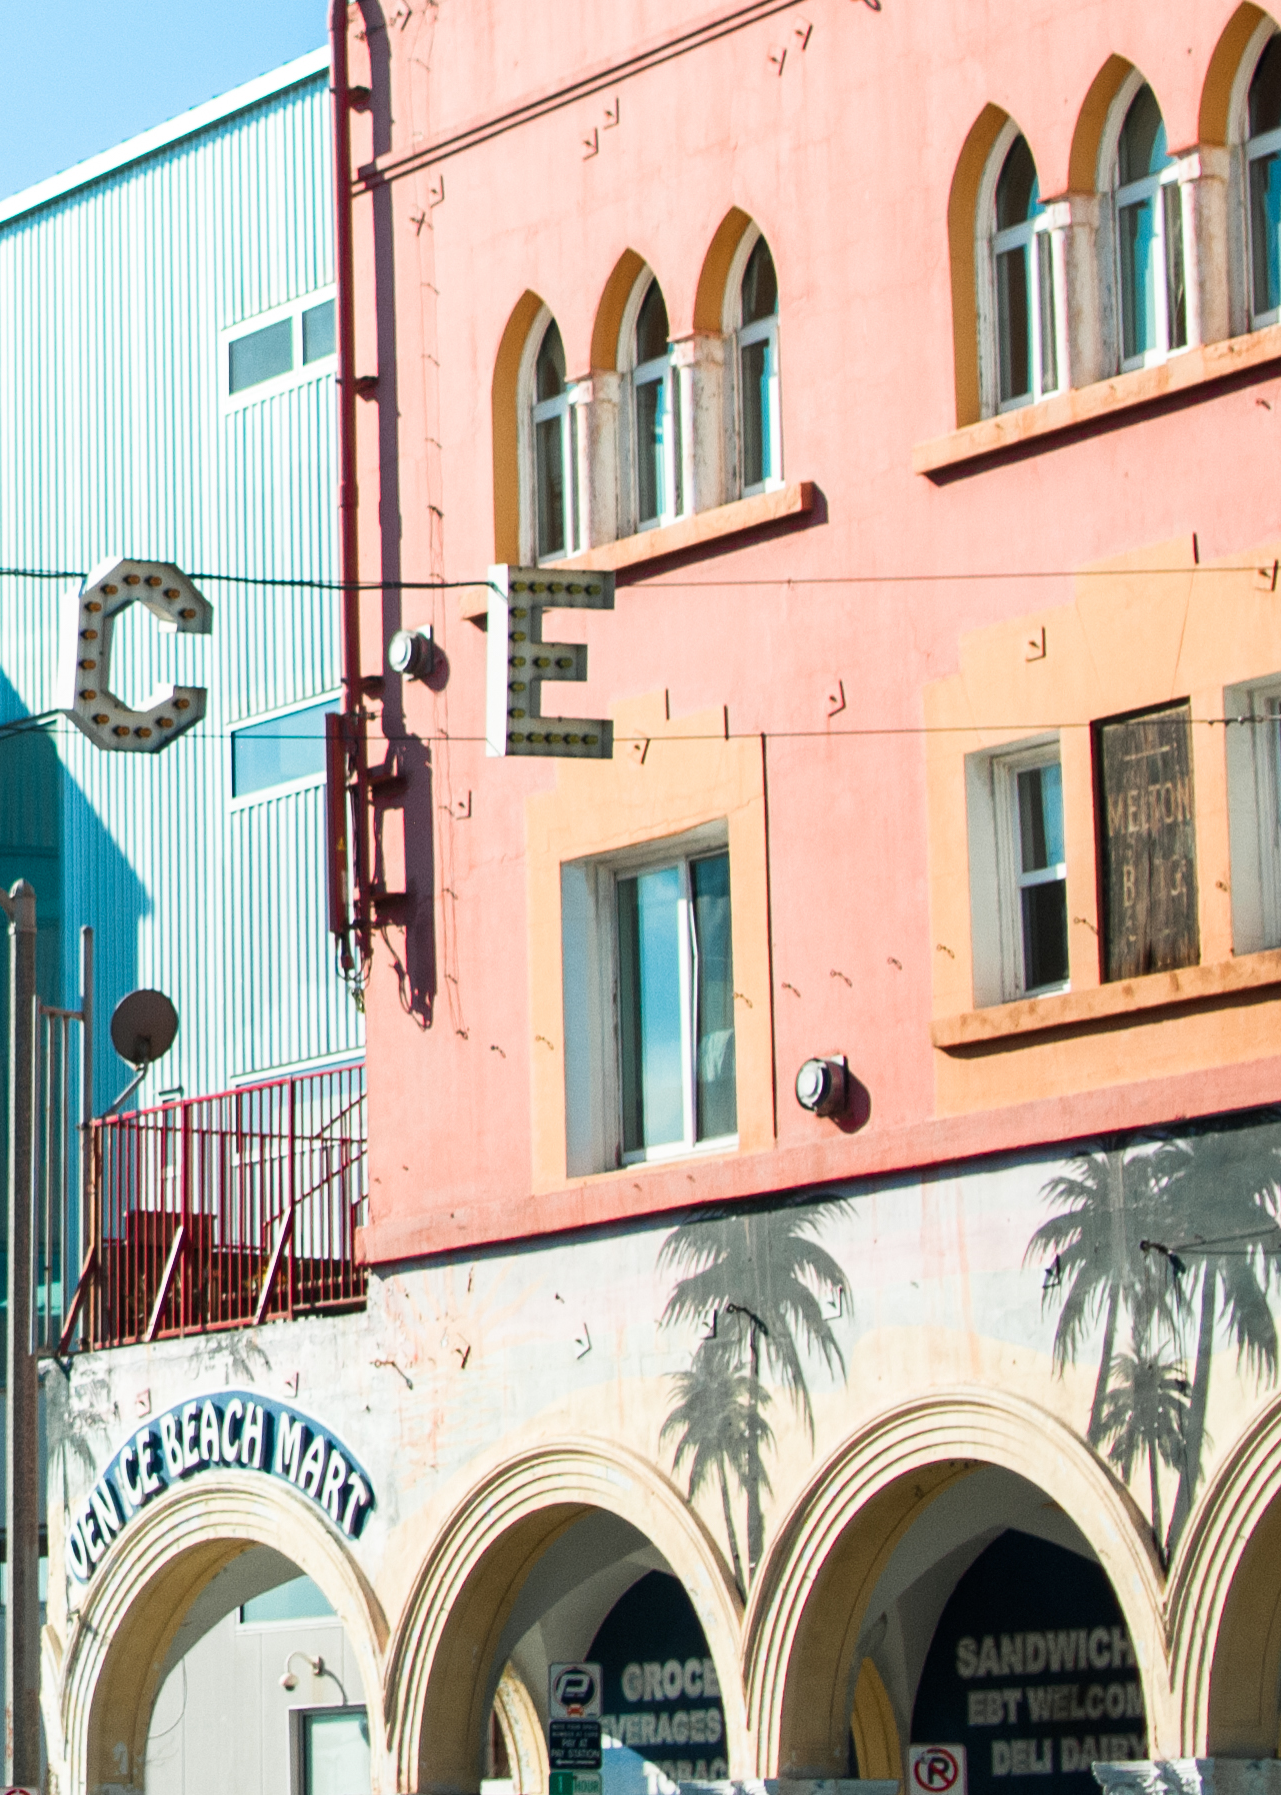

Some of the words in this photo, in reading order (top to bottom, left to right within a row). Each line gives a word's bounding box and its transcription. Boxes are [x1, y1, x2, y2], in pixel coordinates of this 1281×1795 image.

[160, 1398, 264, 1477] BEACH
[275, 1411, 369, 1535] MART
[967, 1689, 1024, 1726] EBT
[992, 1738, 1053, 1776] DELI
